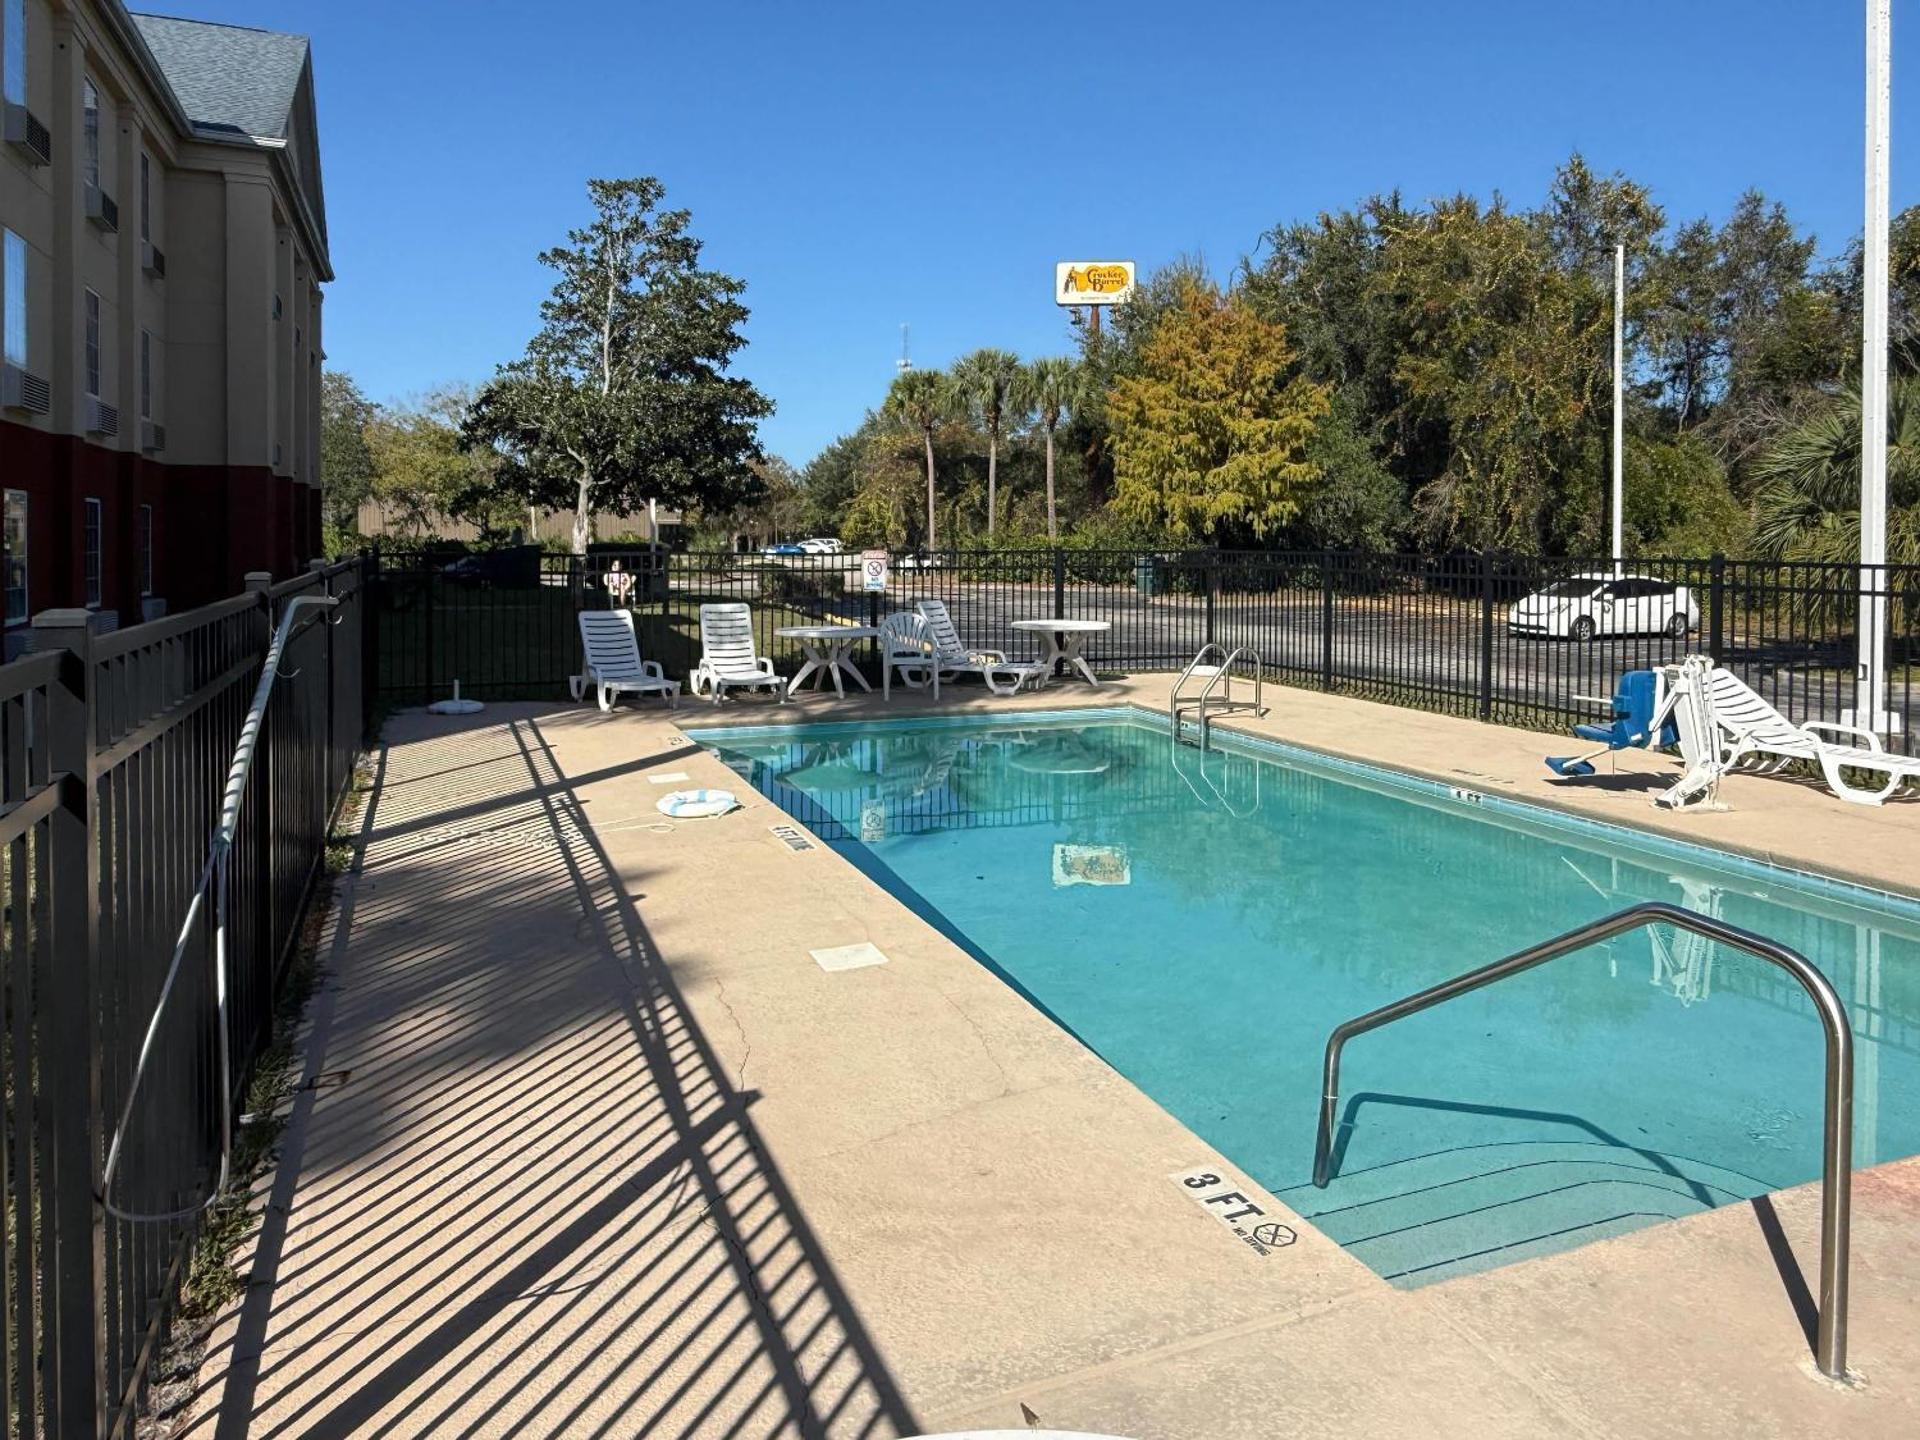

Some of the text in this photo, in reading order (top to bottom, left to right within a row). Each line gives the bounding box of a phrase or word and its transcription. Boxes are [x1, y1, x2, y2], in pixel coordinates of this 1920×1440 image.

[1087, 268, 1121, 284] Cracker
[1093, 278, 1125, 292] Barrel
[1183, 1173, 1266, 1223] 3 FT.
[1233, 1226, 1248, 1237] NO
